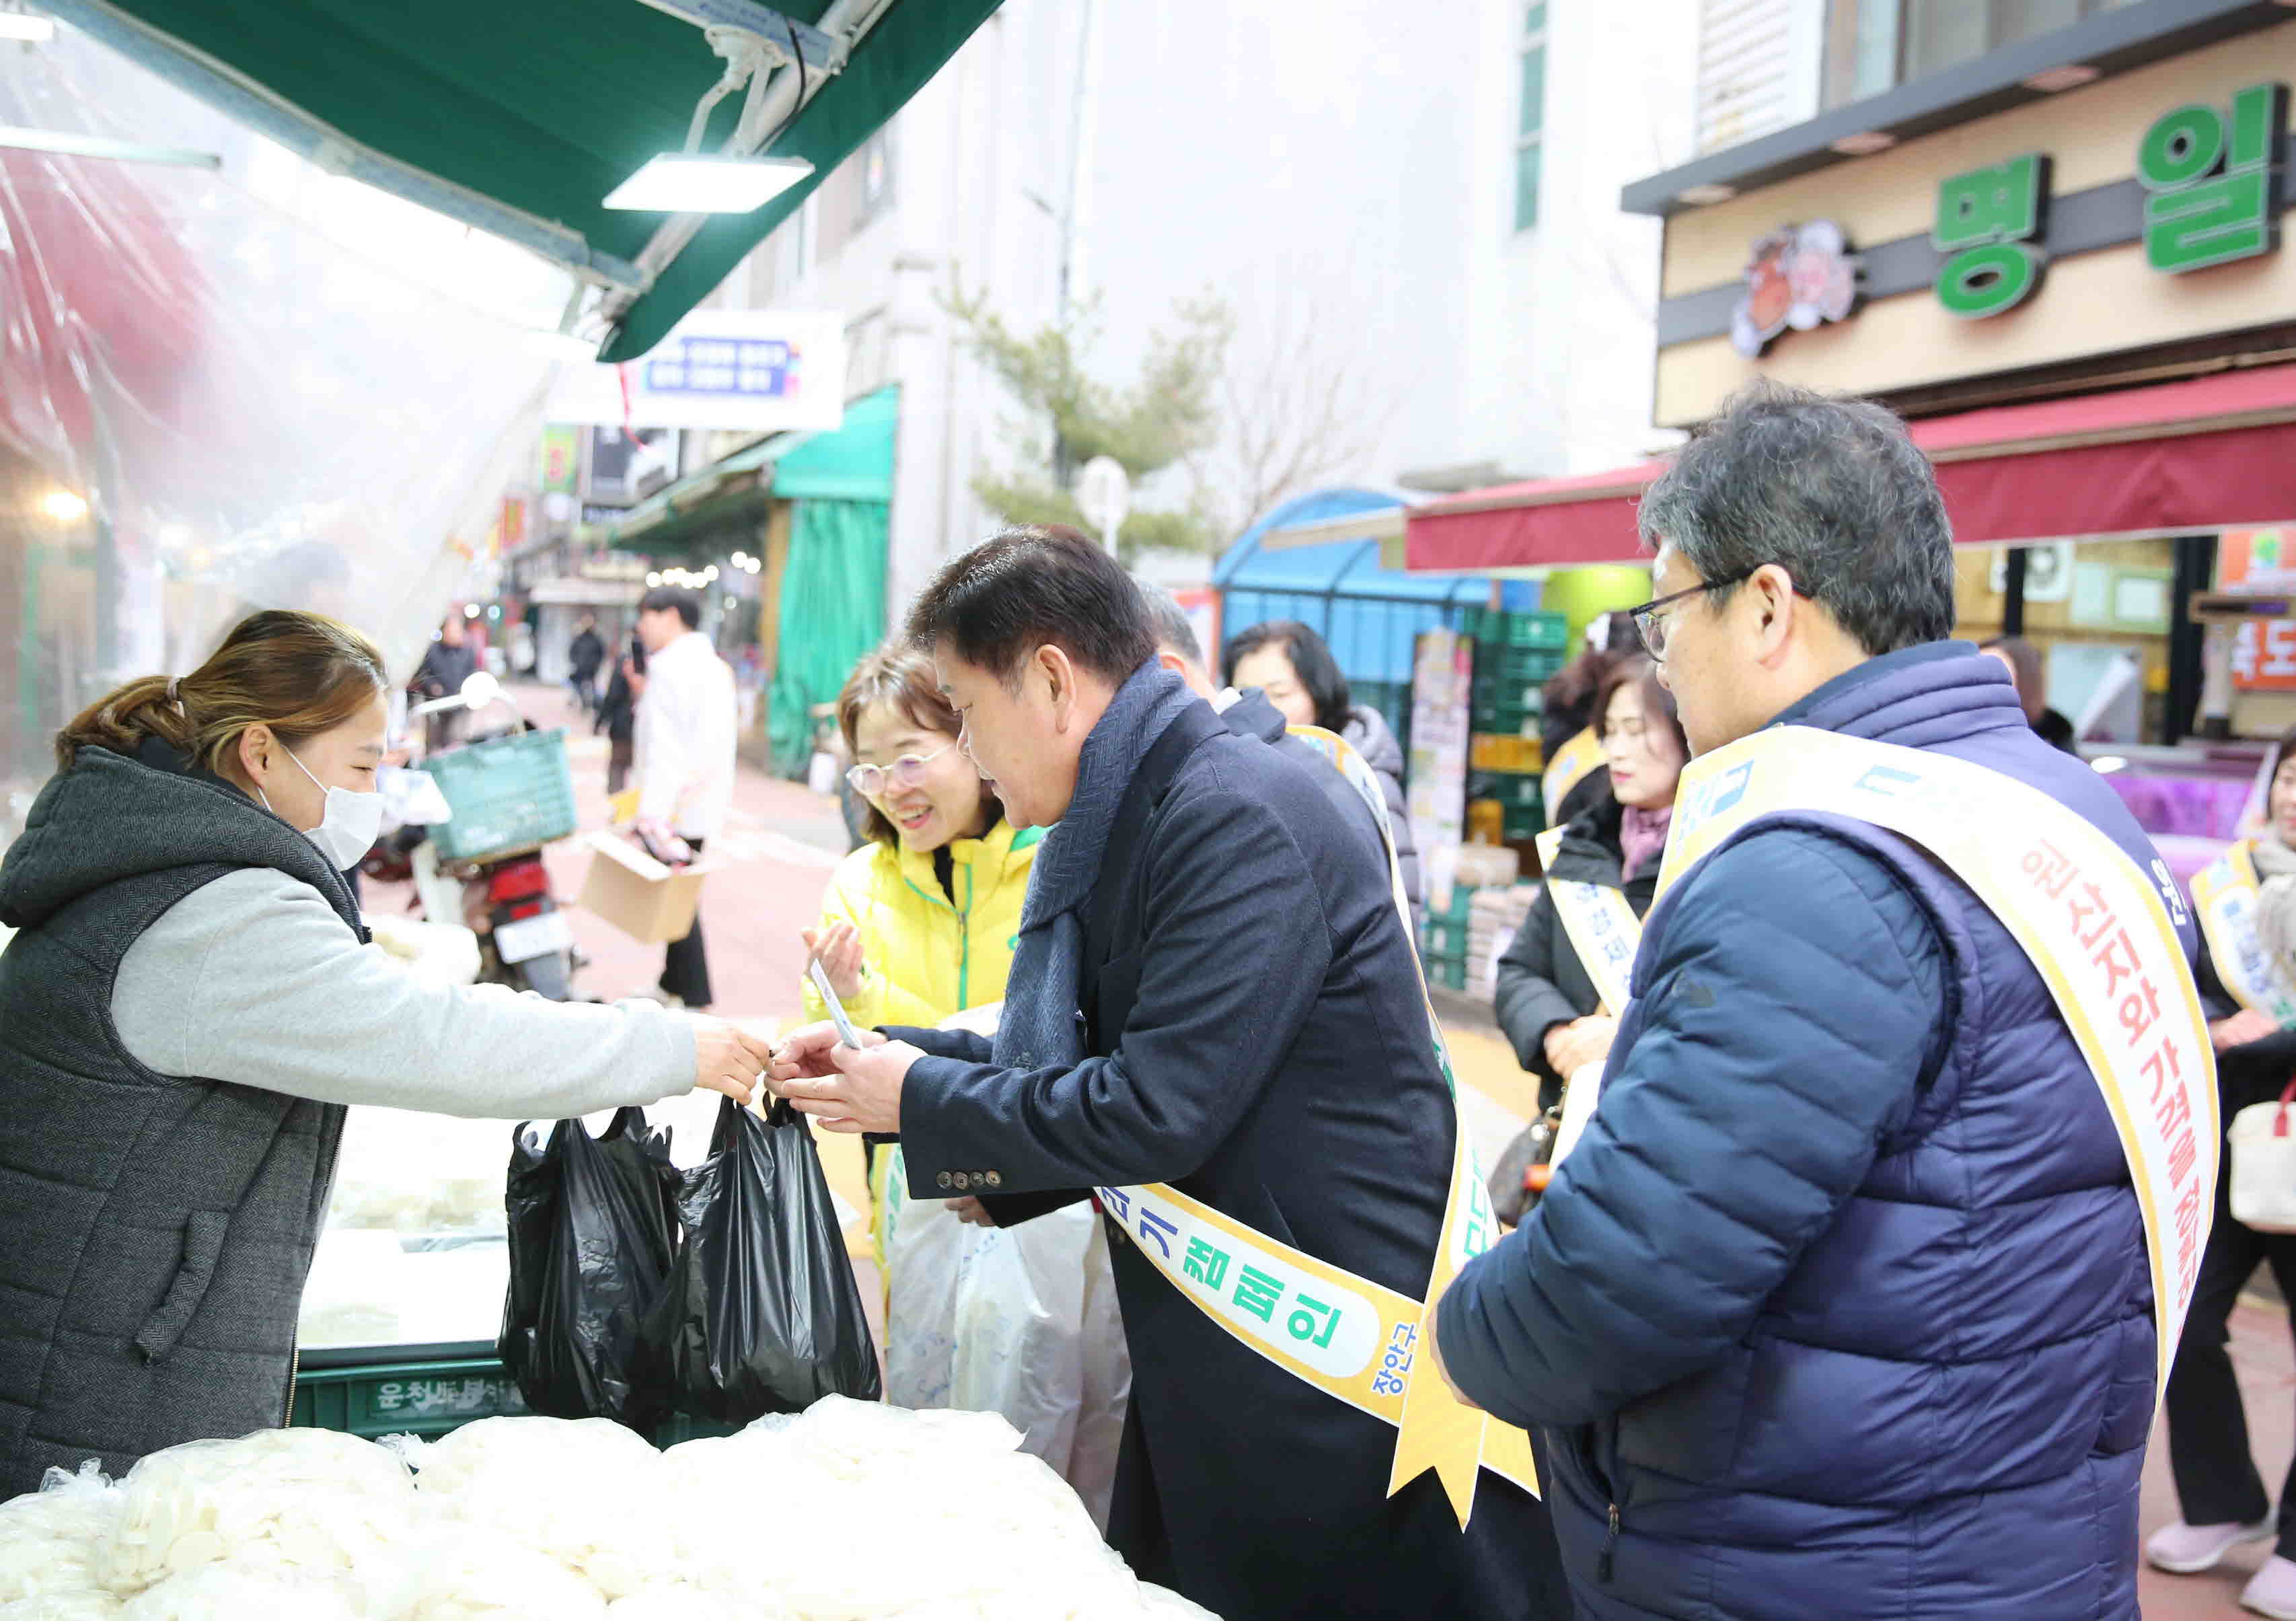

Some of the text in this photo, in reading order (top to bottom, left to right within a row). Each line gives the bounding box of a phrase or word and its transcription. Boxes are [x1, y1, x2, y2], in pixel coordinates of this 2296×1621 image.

[2021, 838, 2160, 1047] 원산지와
[2141, 1036, 2196, 1190] 가격을
[1183, 1235, 1343, 1349] 캠페인
[1372, 1323, 1417, 1395] 장안구
